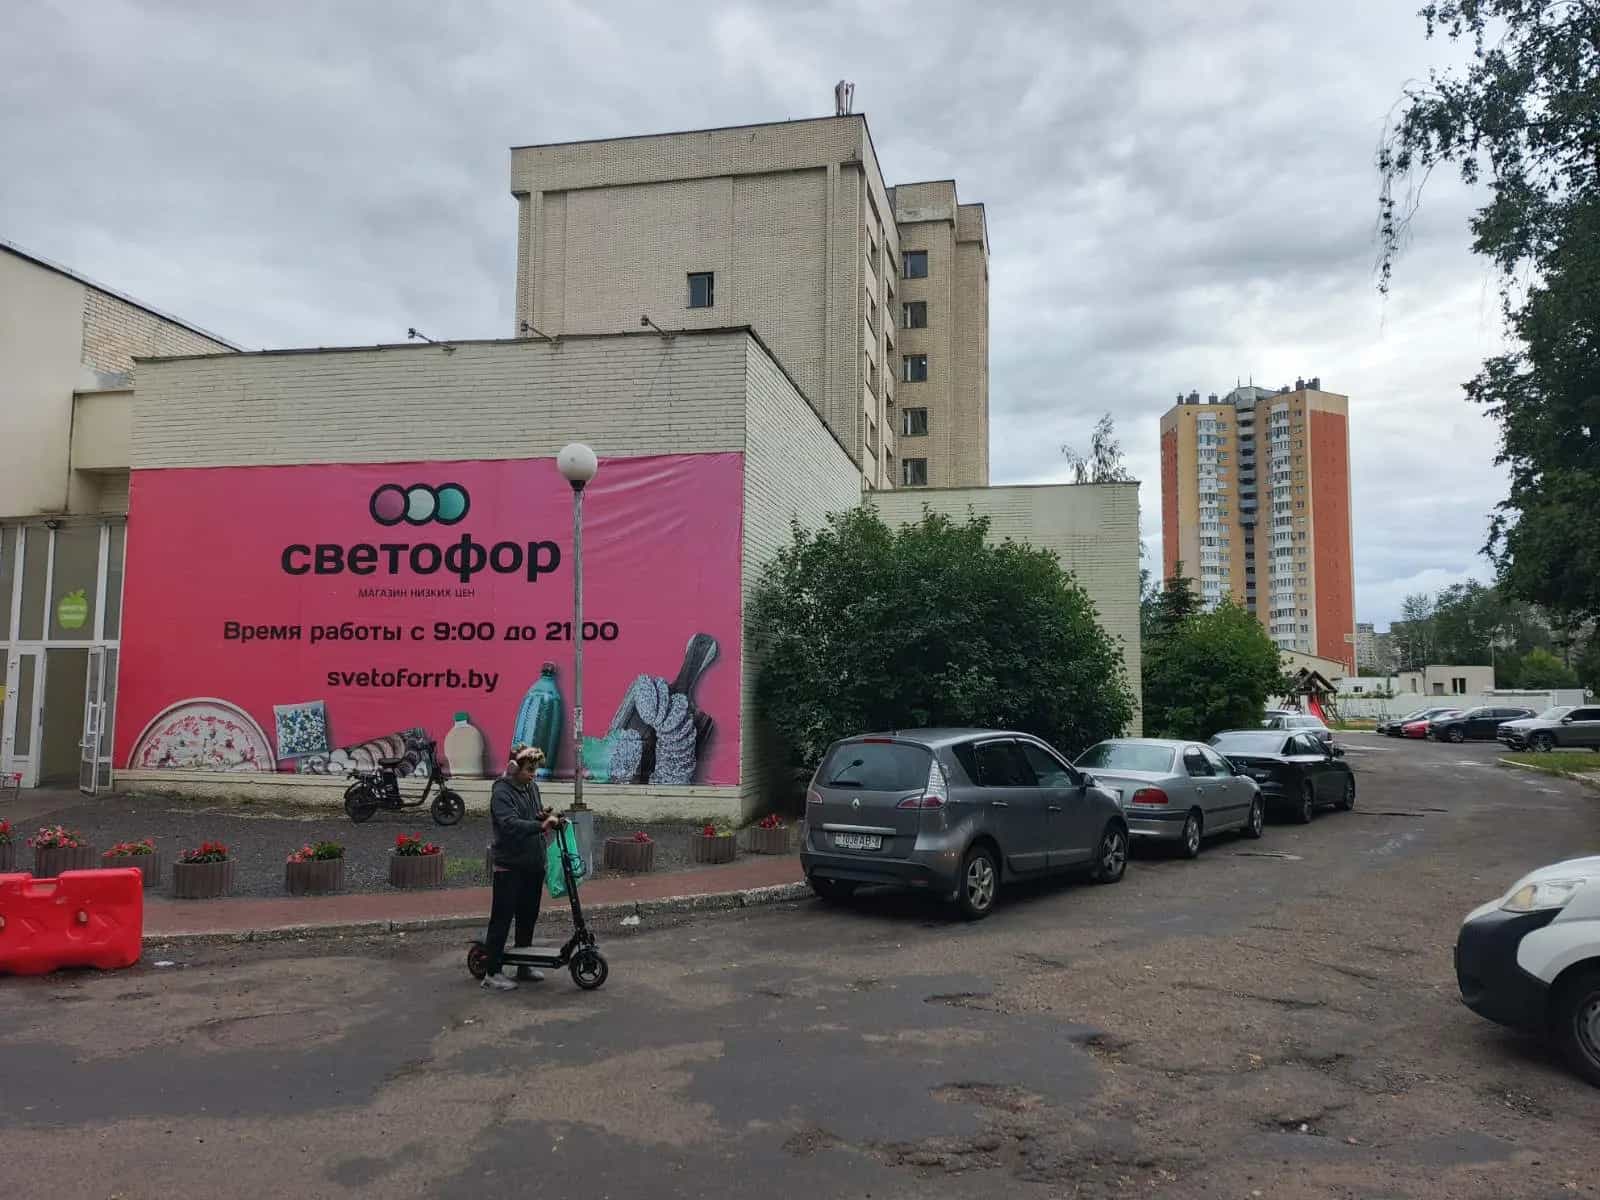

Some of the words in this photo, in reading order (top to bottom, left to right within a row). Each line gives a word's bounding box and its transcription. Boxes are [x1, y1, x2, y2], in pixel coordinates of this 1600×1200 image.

[281, 533, 561, 584] светофор
[358, 588, 408, 599] МАГАЗИН
[410, 588, 452, 598] НИЗКИХ
[455, 587, 475, 599] ЦЕН
[223, 622, 301, 644] Время
[310, 622, 401, 644] работы
[411, 627, 425, 641] с
[433, 622, 495, 641] 9:00
[504, 627, 536, 641] до
[545, 621, 619, 641] 2100
[327, 668, 499, 693] svetoforrb.by
